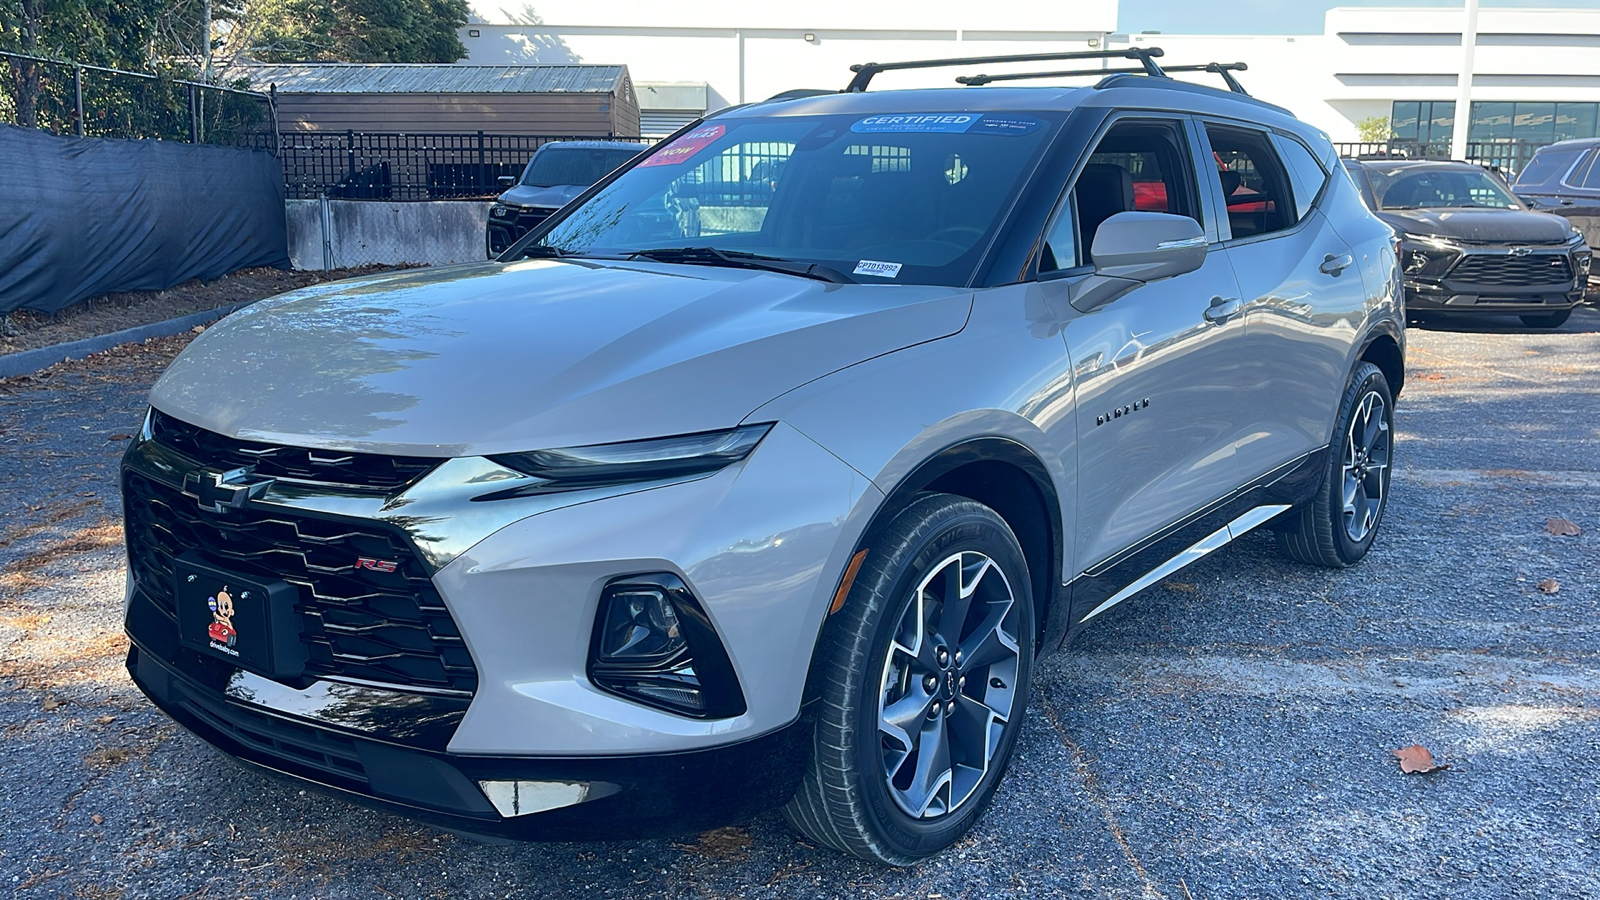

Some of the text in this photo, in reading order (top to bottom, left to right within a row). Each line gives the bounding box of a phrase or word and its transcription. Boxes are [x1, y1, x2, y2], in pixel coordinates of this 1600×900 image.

[862, 115, 971, 125] CERTIFIED
[660, 146, 695, 157] NOW
[857, 261, 898, 272] CPT013992
[1096, 397, 1150, 426] BLAZER
[354, 557, 398, 573] RS
